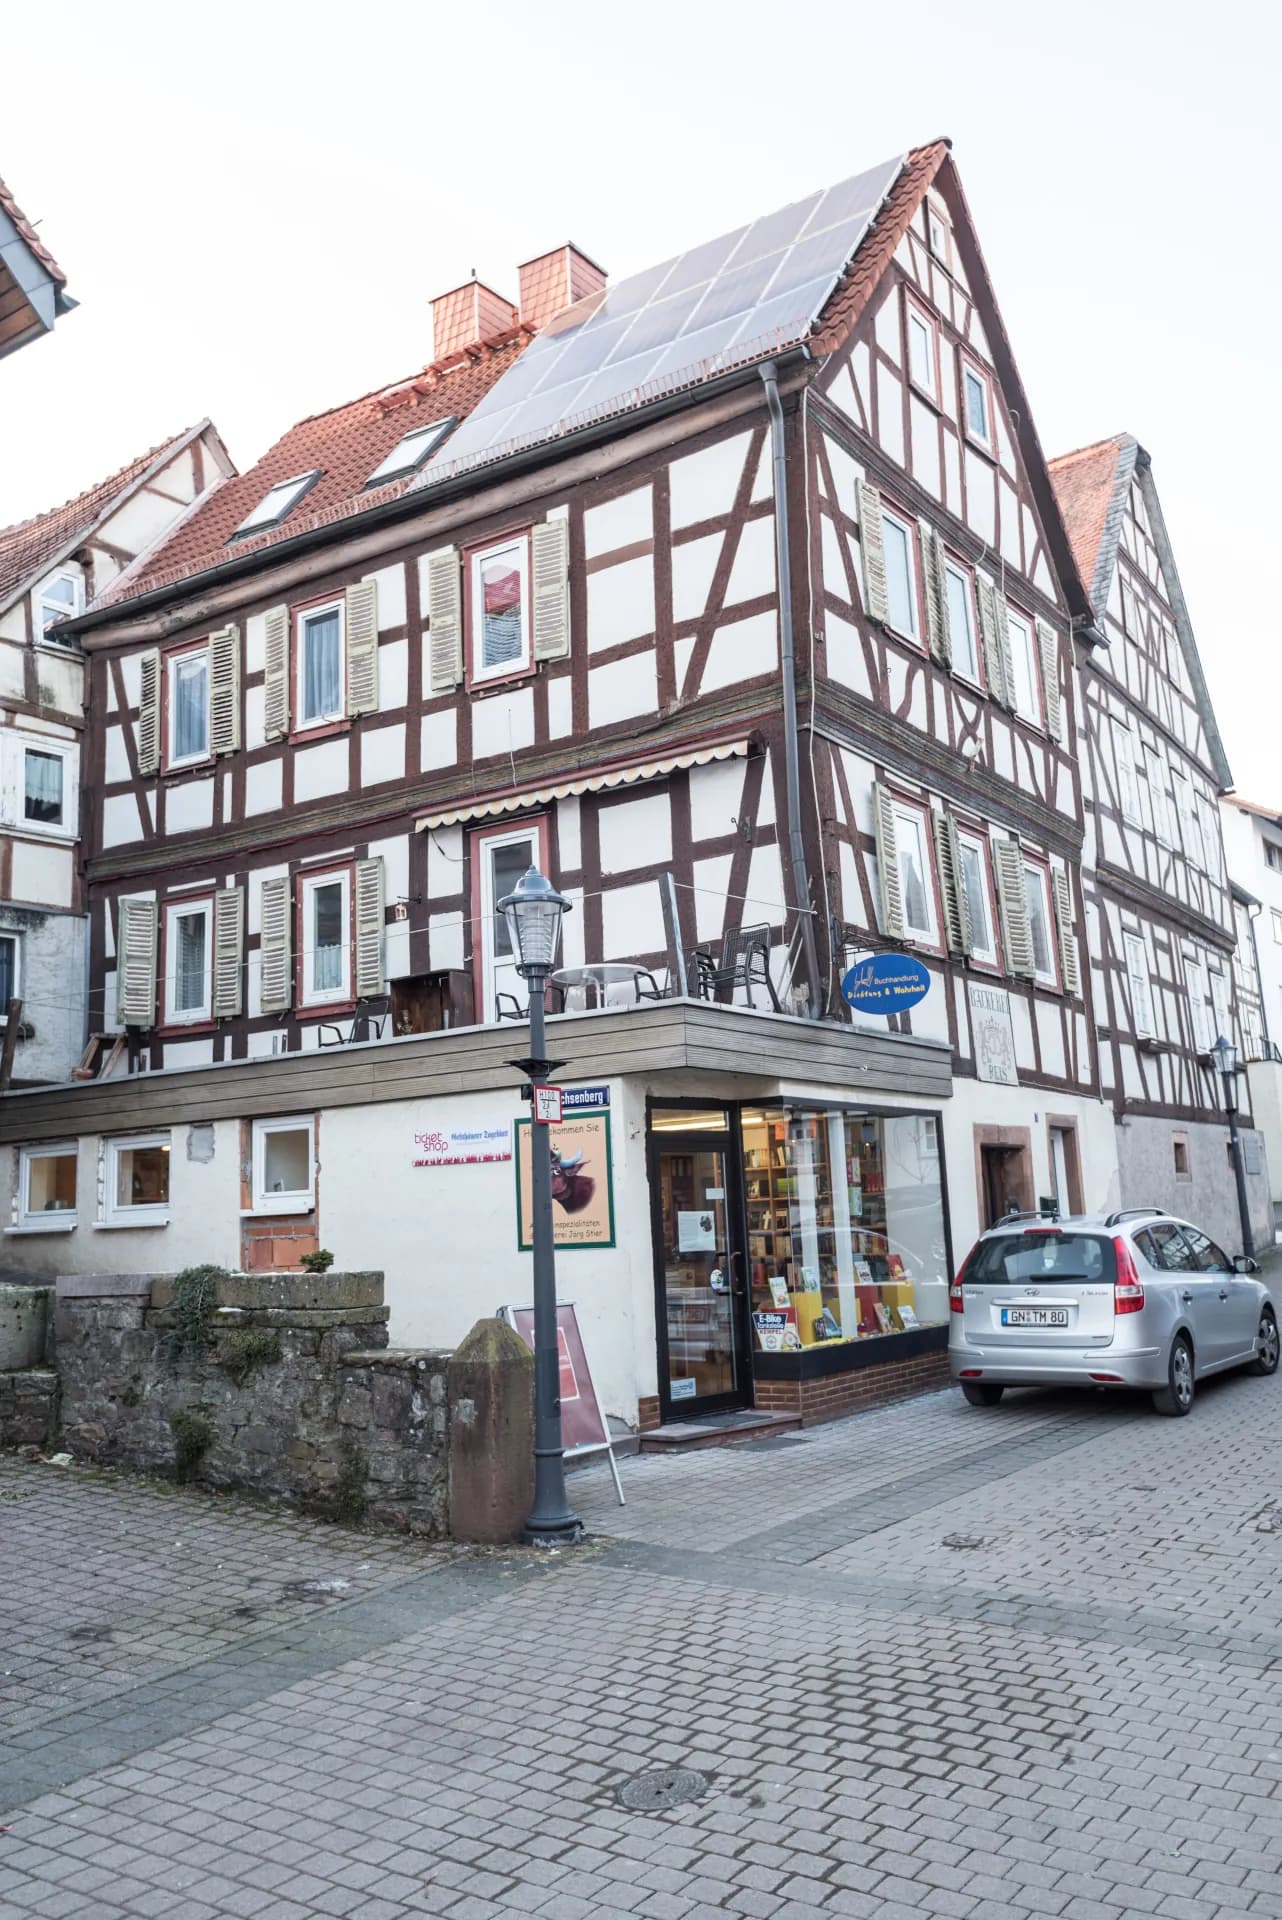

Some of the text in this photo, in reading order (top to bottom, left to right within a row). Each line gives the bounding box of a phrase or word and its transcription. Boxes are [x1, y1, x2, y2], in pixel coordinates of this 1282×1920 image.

[874, 975, 919, 985] Buchhandlung
[847, 984, 926, 999] Dichtung & Wahrheit
[561, 1090, 604, 1104] chsenberg
[586, 1123, 600, 1132] Sie
[414, 1132, 443, 1144] ticket
[423, 1141, 448, 1153] shop
[759, 1314, 782, 1323] E-Bike
[1011, 1311, 1065, 1323] GN TM 80
